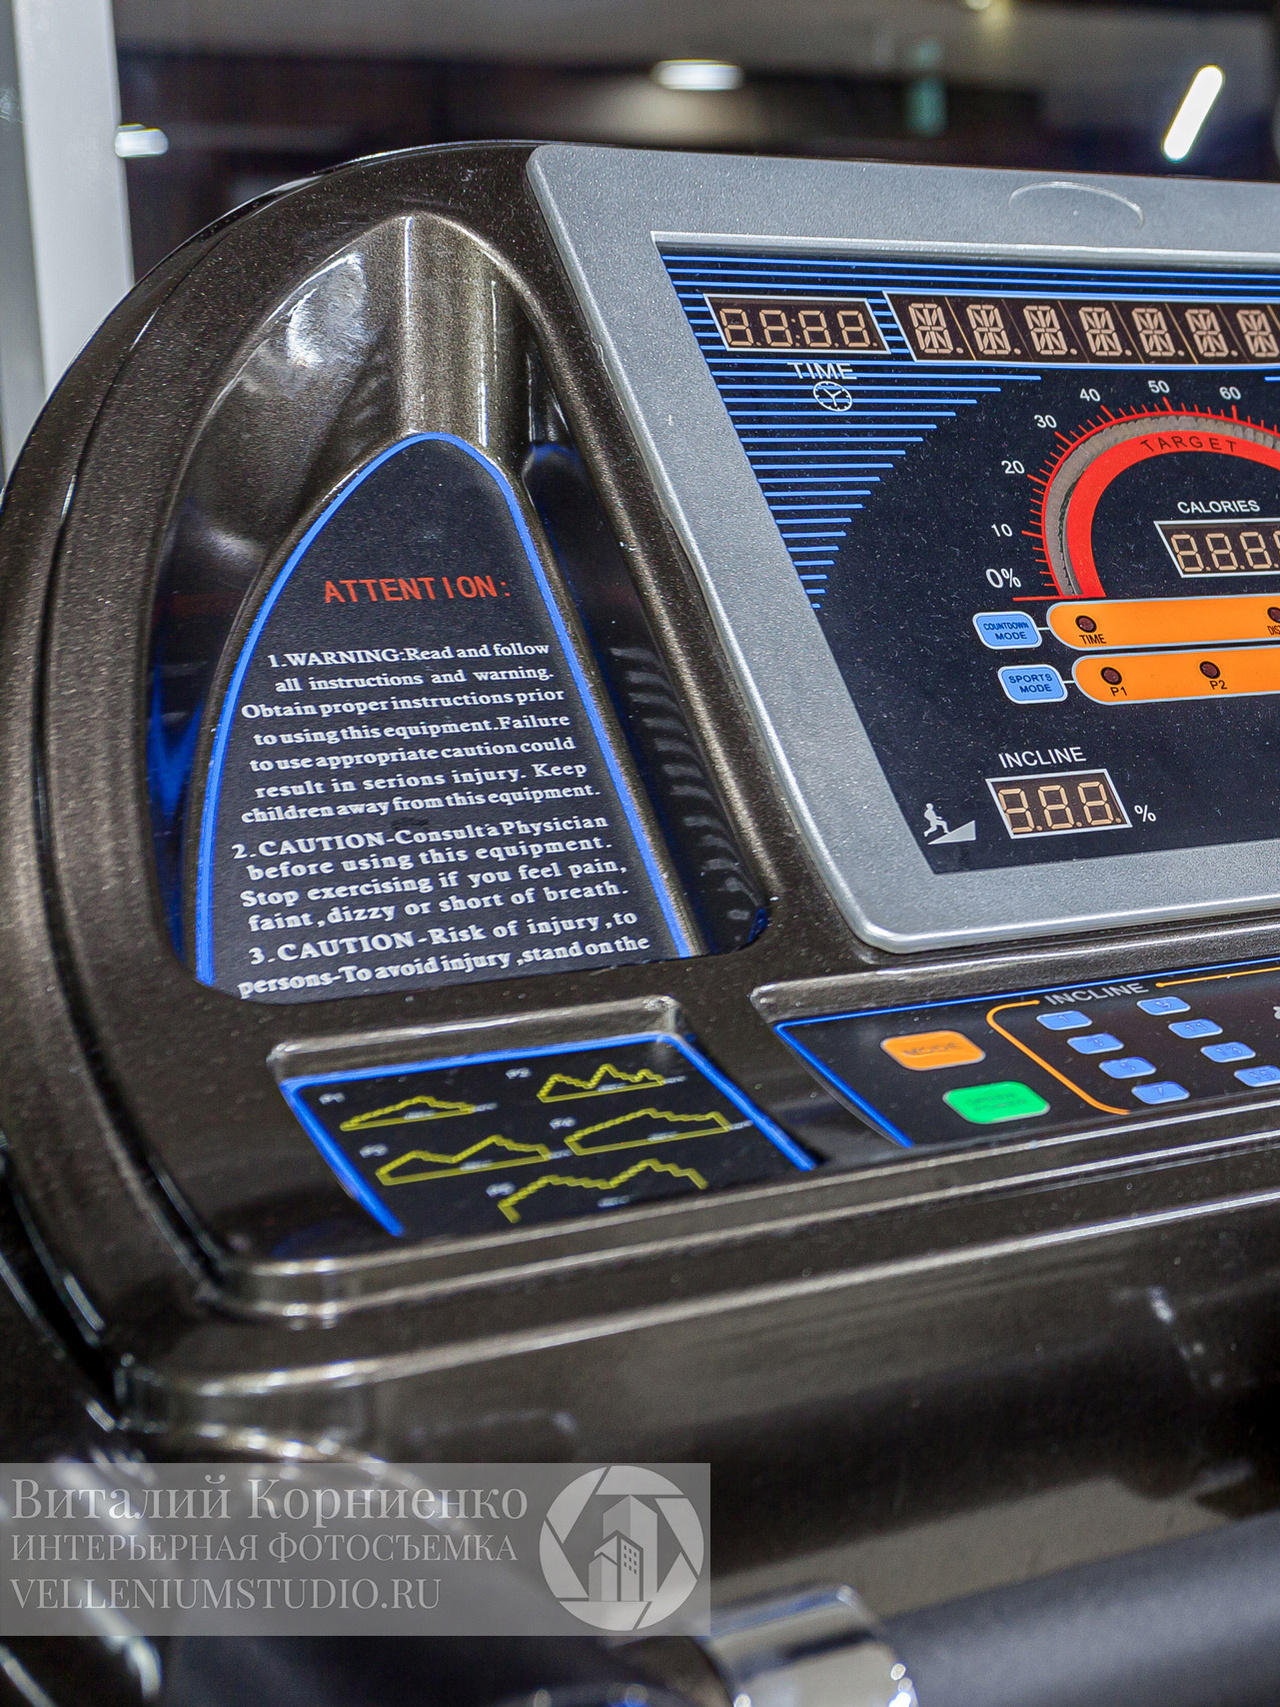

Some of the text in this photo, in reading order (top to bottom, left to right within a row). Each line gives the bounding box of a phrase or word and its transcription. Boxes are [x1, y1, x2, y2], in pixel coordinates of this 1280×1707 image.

[786, 362, 857, 380] TIME
[1079, 387, 1101, 403] 40
[1148, 379, 1170, 394] 50
[1219, 385, 1242, 401] 60
[1033, 413, 1058, 430] 30
[1139, 434, 1238, 453] TARGET
[1001, 460, 1025, 475] 20
[1176, 499, 1261, 515] CALORIES
[990, 522, 1013, 538] 10
[985, 567, 1022, 589] 0%
[324, 575, 511, 603] ATTENTION:
[983, 620, 1029, 631] COUNTDOWN
[994, 630, 1028, 641] MODE
[1079, 633, 1107, 645] TIME
[456, 644, 491, 659] and
[493, 642, 550, 658] follow
[275, 665, 554, 693] all instructions and warning.
[1008, 673, 1053, 685] SPORTS
[1209, 679, 1228, 691] P2
[1019, 683, 1053, 694] MODE
[1110, 685, 1128, 697] P1
[241, 688, 565, 719] Obtain proper instructions prior
[253, 733, 278, 746] to
[279, 728, 341, 745] using
[340, 725, 381, 741] this
[249, 736, 577, 773] to use appropriate caution could
[998, 746, 1087, 769] INCLINE
[255, 780, 326, 799] result
[331, 778, 357, 794] in
[451, 768, 527, 787] injury.
[531, 762, 588, 780] Keep
[241, 783, 600, 824] children away from this equipment.
[1134, 804, 1157, 822] %
[500, 815, 609, 837] Physician
[246, 834, 613, 883] before using this equipment.
[240, 858, 627, 908] Stop exercising if you feel pain,
[404, 900, 433, 916] or
[438, 893, 506, 913] short
[510, 887, 537, 905] of
[543, 880, 629, 902] breath.
[492, 920, 519, 938] of
[374, 956, 441, 978] avoid
[584, 940, 615, 957] on
[614, 935, 651, 953] the
[1044, 982, 1149, 1006] INCLINE
